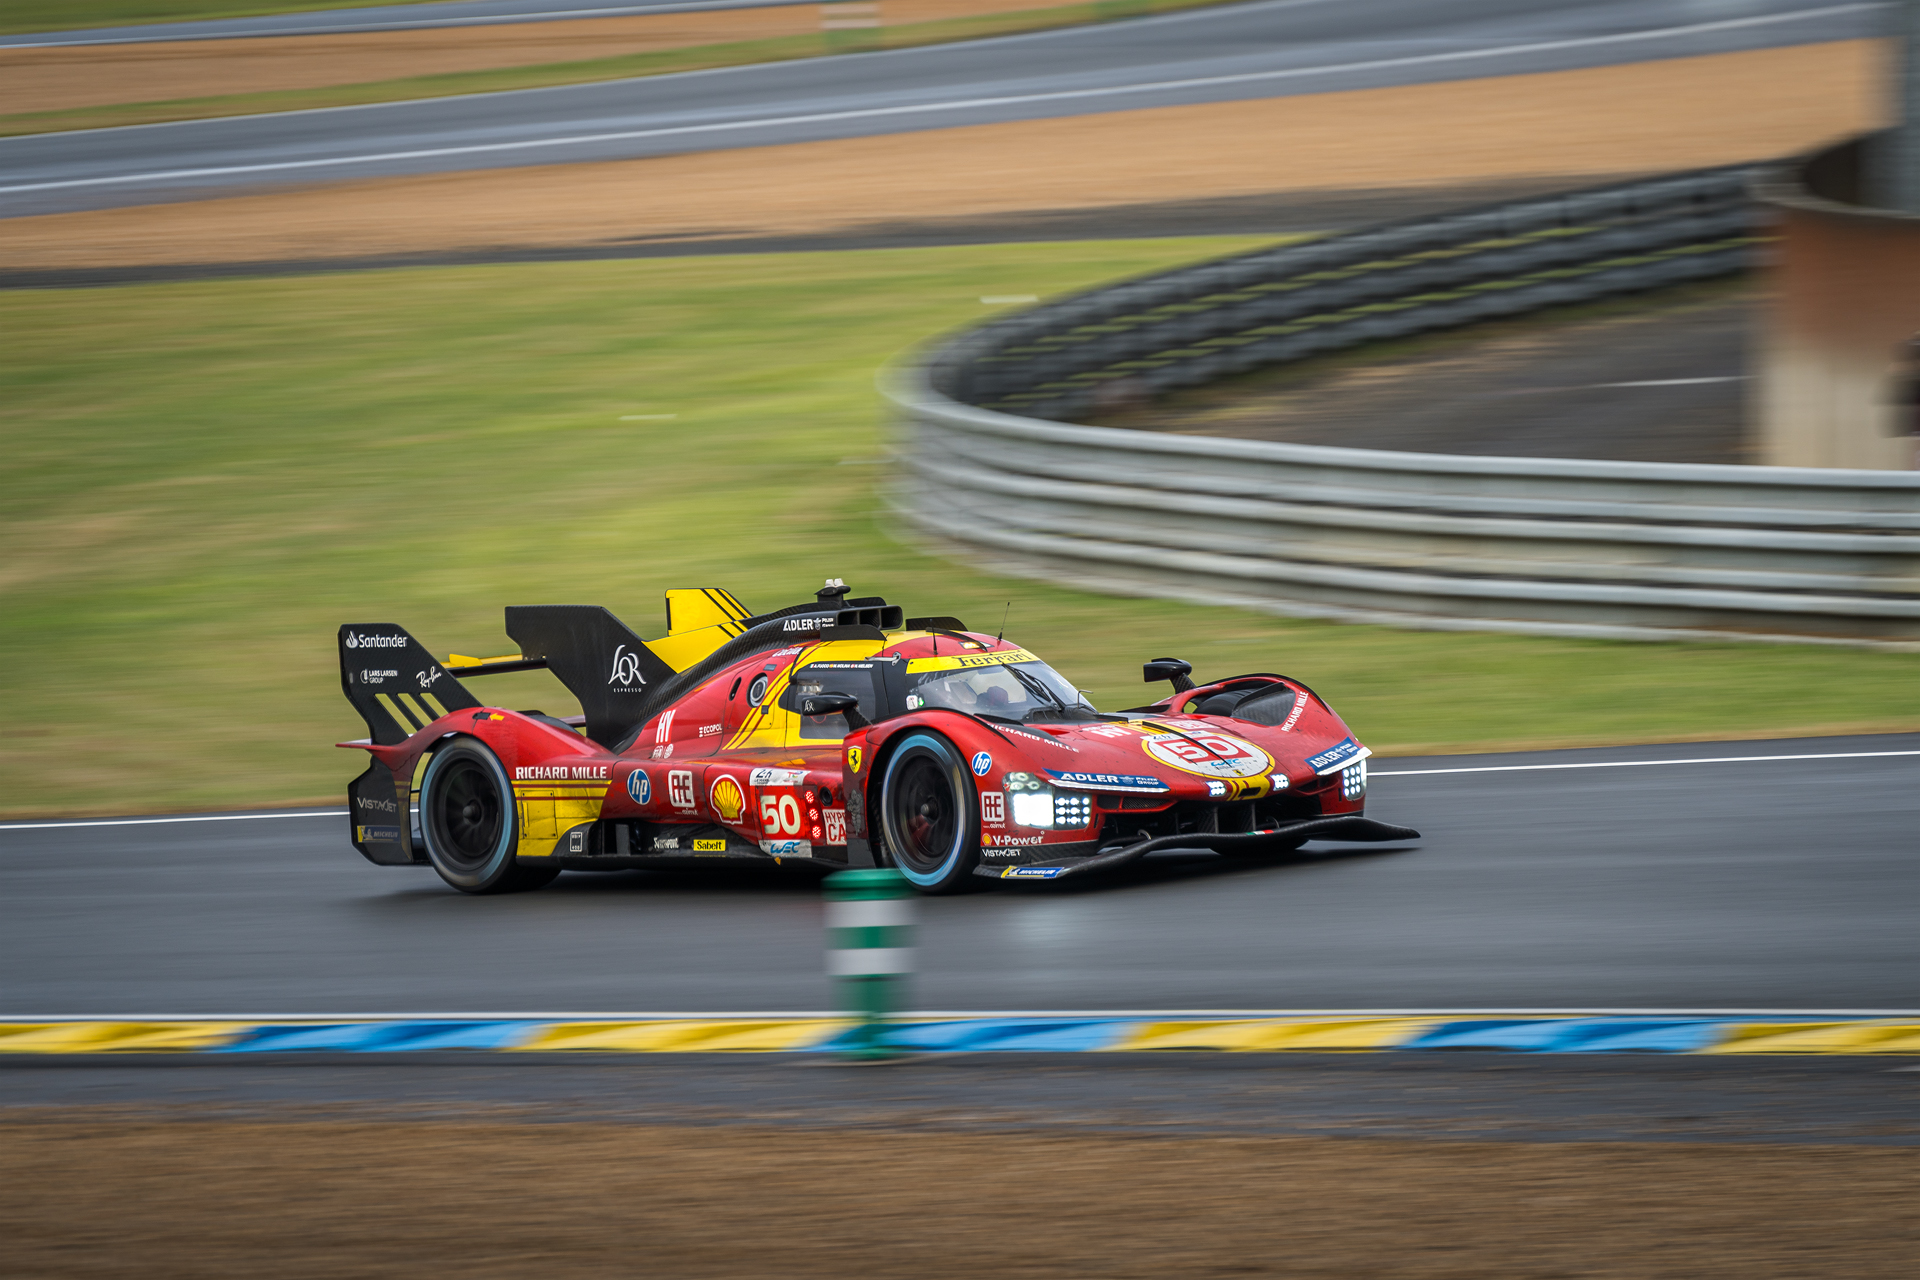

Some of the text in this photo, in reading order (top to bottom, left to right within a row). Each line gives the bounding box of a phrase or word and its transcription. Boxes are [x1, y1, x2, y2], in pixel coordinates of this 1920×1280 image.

[783, 618, 814, 631] ADLER
[358, 634, 408, 648] Santander
[952, 649, 1032, 667] Ferrari
[975, 752, 991, 775] hp
[1309, 751, 1343, 768] ADLER
[515, 766, 607, 780] RICHARD MILLE
[1061, 773, 1119, 784] ADLER
[631, 769, 648, 804] hp
[760, 794, 801, 835] 50
[697, 840, 722, 850] Sabelt
[993, 835, 1043, 846] V-Power
